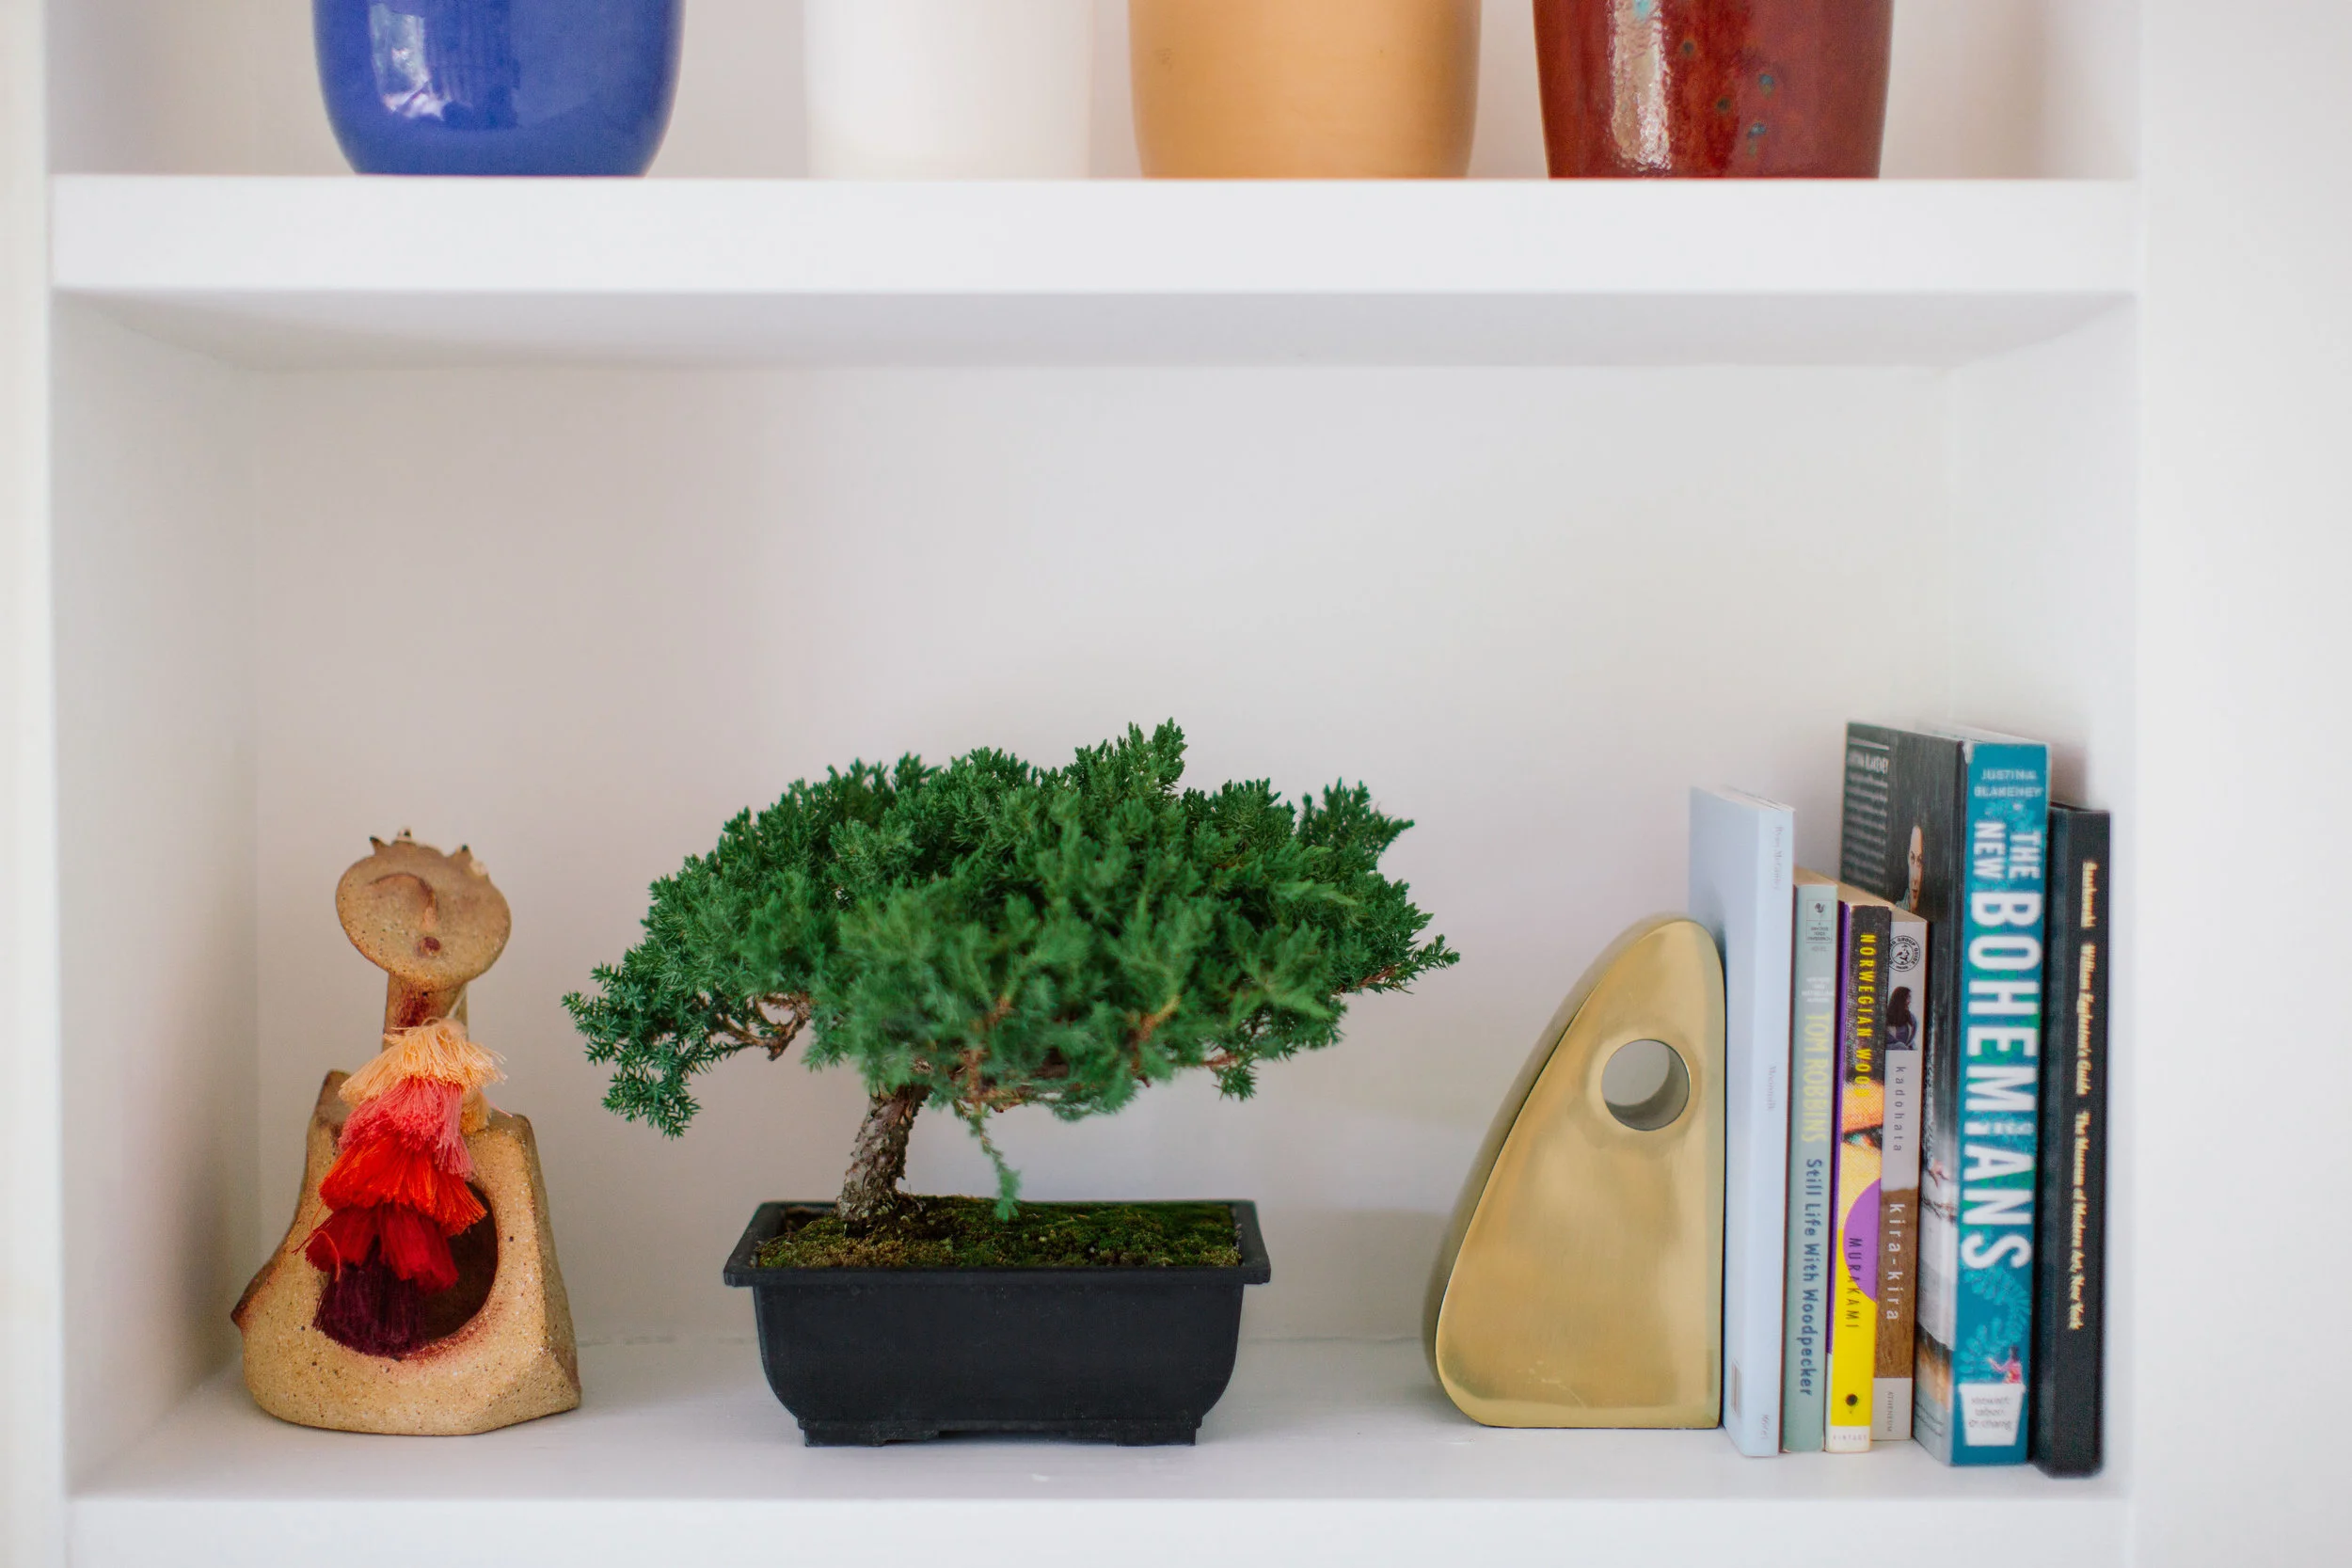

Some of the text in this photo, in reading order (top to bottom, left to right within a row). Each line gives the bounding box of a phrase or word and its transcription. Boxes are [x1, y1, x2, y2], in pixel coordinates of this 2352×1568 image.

[1973, 785, 2043, 798] BLAKENEY
[1980, 768, 2037, 780] JUSTINA
[1973, 820, 2007, 879] NEW
[2009, 829, 2042, 879] THE
[1911, 947, 1919, 965] GUIDE
[2078, 942, 2096, 990] William
[1804, 1011, 1831, 1053] TOM
[1851, 933, 1878, 1100] NORWEGIAN WOOD
[1800, 1057, 1829, 1144] ROBBINS
[1960, 890, 2042, 1271] BOHEMIANS
[2074, 1059, 2091, 1096] Guide
[1892, 1066, 1908, 1153] kadohata
[2073, 1111, 2090, 1135] The
[2073, 1136, 2090, 1186] Museum
[2072, 1187, 2088, 1201] of
[2071, 1202, 2088, 1248] Modern
[1796, 1158, 1823, 1397] Still Life With Woodpecker
[1844, 1236, 1864, 1330] MURAKAMI
[1885, 1202, 1906, 1322] kira-kira
[2070, 1274, 2085, 1301] New
[2068, 1301, 2084, 1330] York
[1885, 1390, 1895, 1433] ATHENEUM
